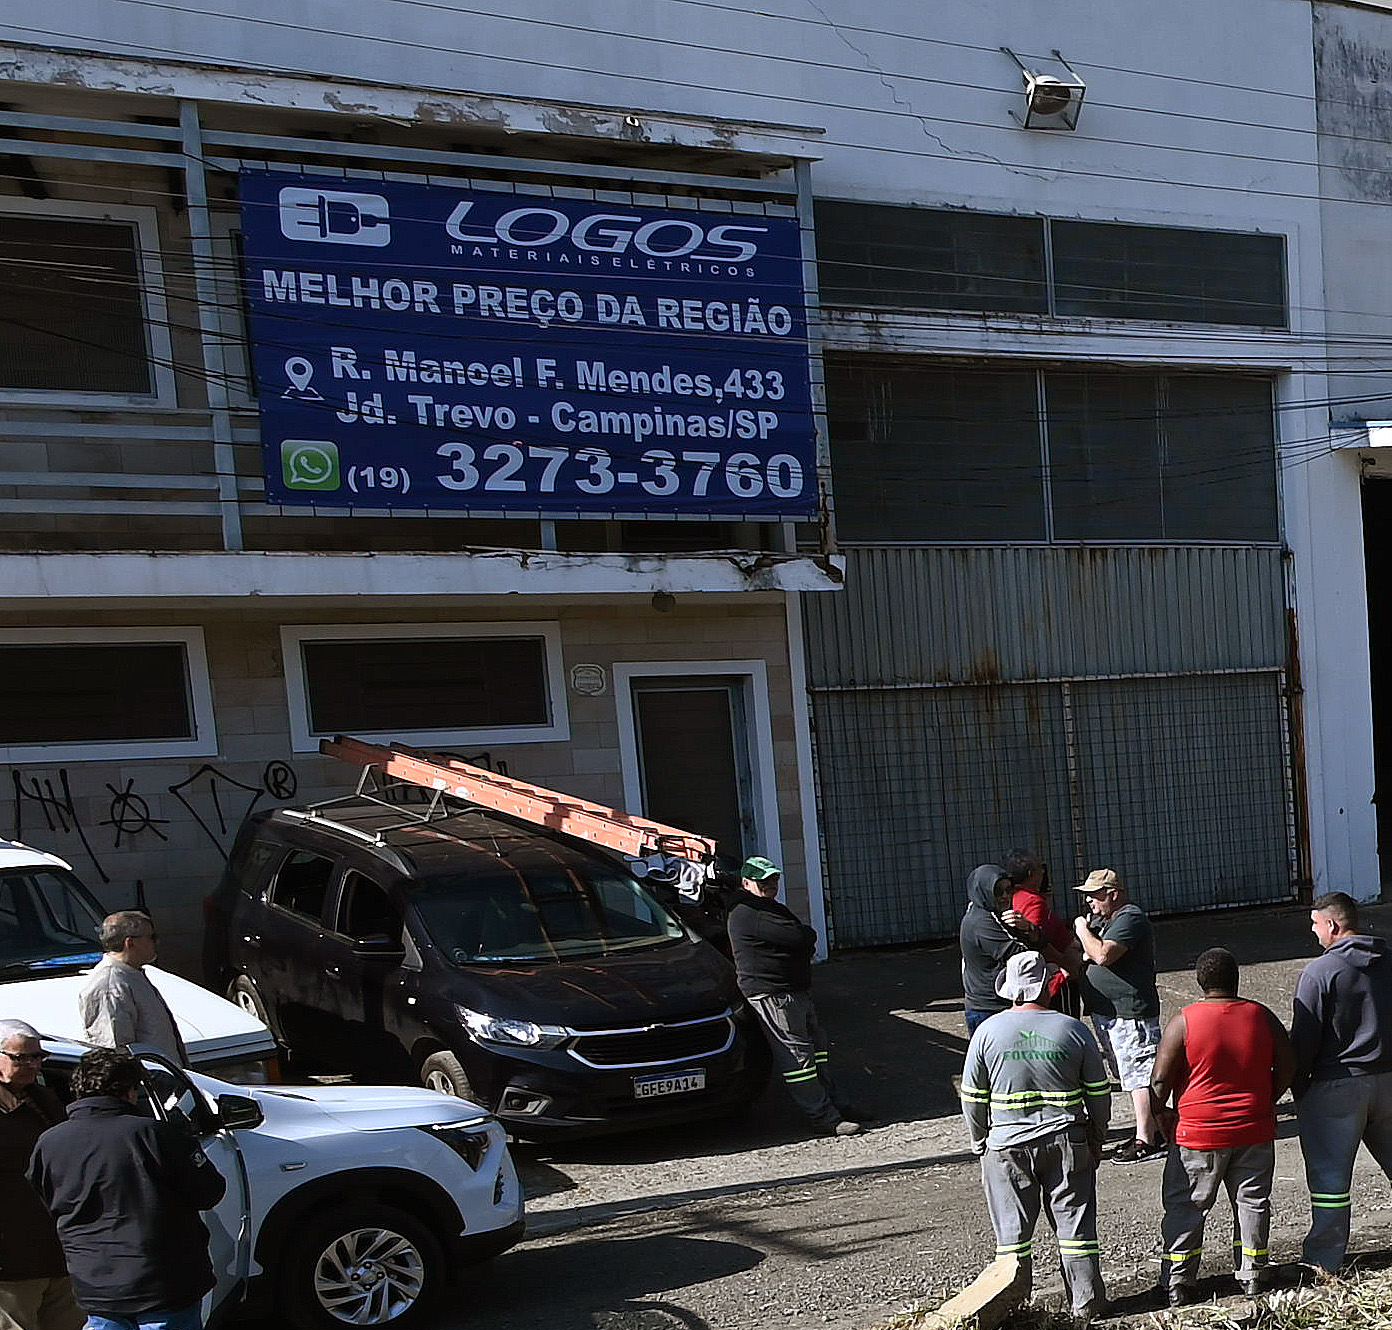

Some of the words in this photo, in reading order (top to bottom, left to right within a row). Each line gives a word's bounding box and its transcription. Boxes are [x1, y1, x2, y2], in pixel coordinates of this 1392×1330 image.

[446, 201, 768, 262] LOGOS
[451, 245, 600, 266] MATERIAIS
[262, 269, 442, 314] MELHOR
[453, 283, 583, 328] PREÇO
[597, 294, 646, 327] DA
[658, 298, 792, 335] REGIÃO
[331, 346, 372, 380] R.
[385, 350, 524, 388] Manoel
[536, 358, 564, 389] F.
[576, 361, 785, 404] Mendes,433
[336, 392, 397, 425] Jd.
[408, 394, 516, 430] Trevo
[551, 401, 779, 442] Campinas/SP
[348, 466, 411, 494] (19)
[436, 442, 804, 498] 3273-3760
[641, 1077, 698, 1096] GFE9A14
